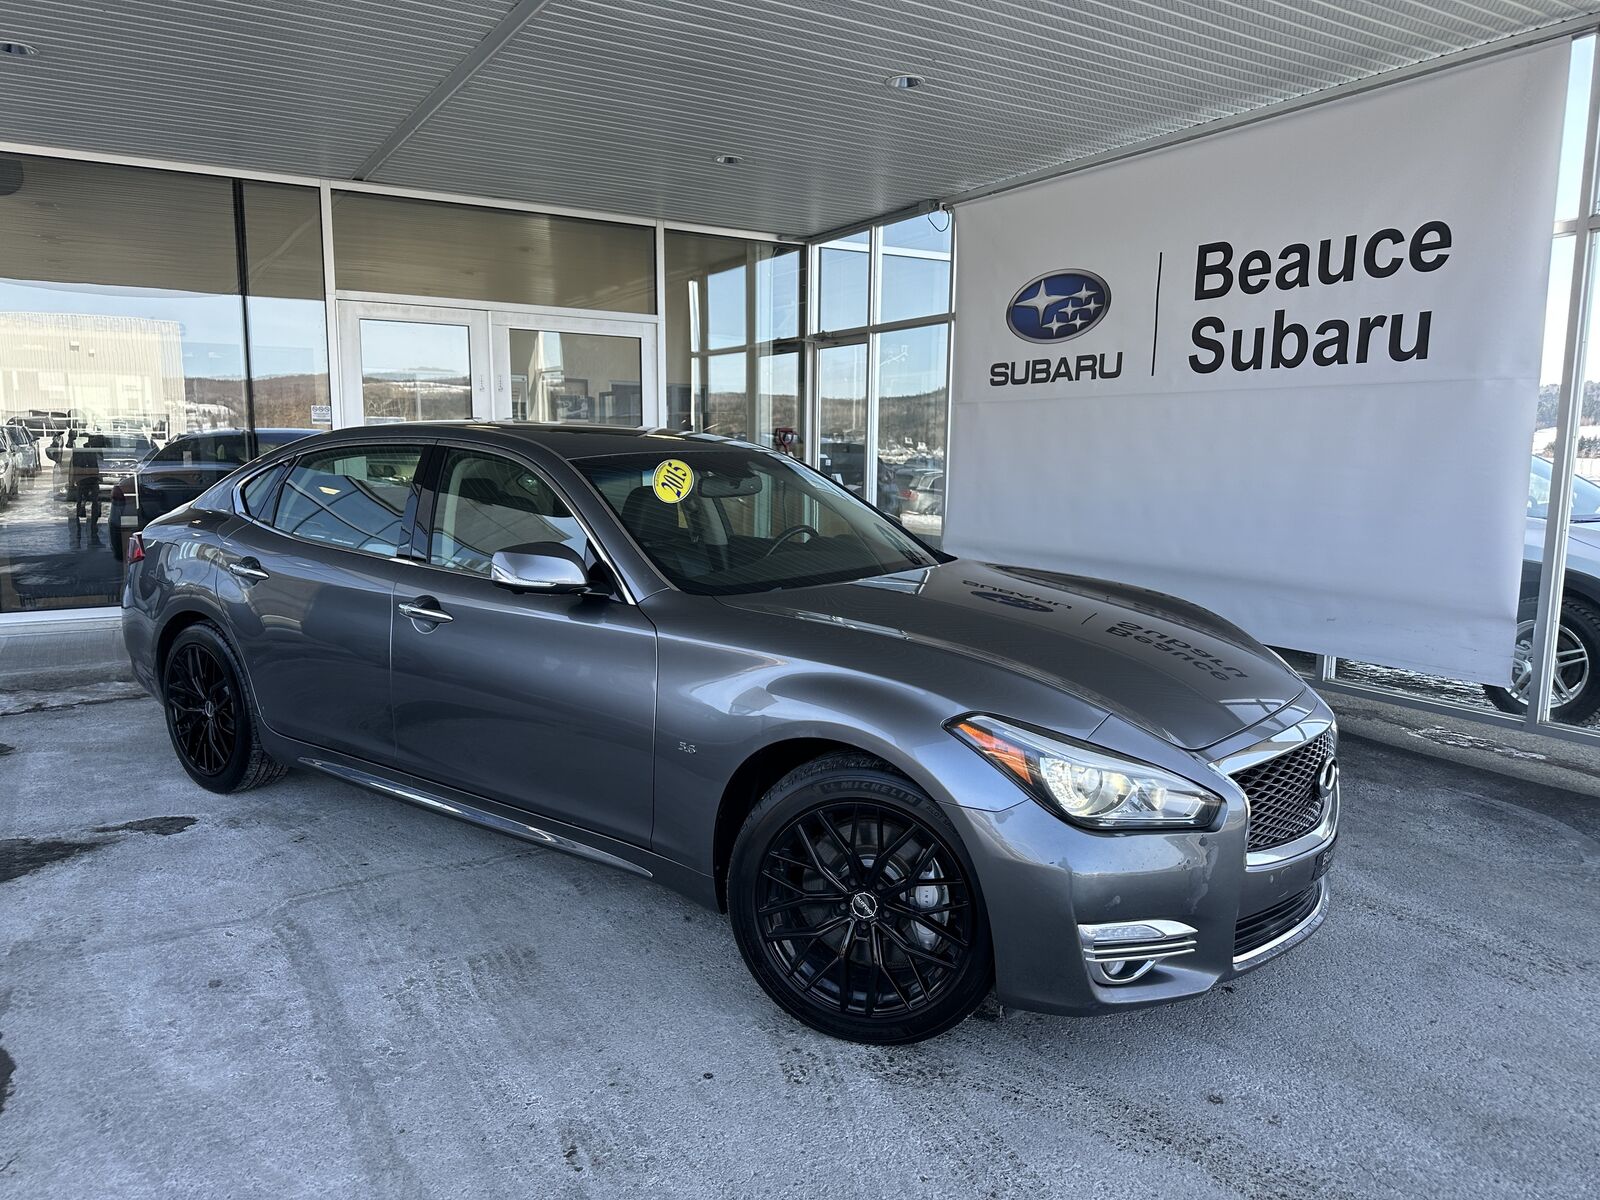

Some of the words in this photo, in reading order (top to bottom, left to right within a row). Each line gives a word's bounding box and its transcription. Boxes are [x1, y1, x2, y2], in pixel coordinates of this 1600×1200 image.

[1193, 219, 1453, 301] Beauce
[1188, 309, 1433, 374] Subaru
[989, 351, 1123, 387] SUBARU
[661, 461, 687, 498] 2015
[840, 781, 918, 803] MICHELIN
